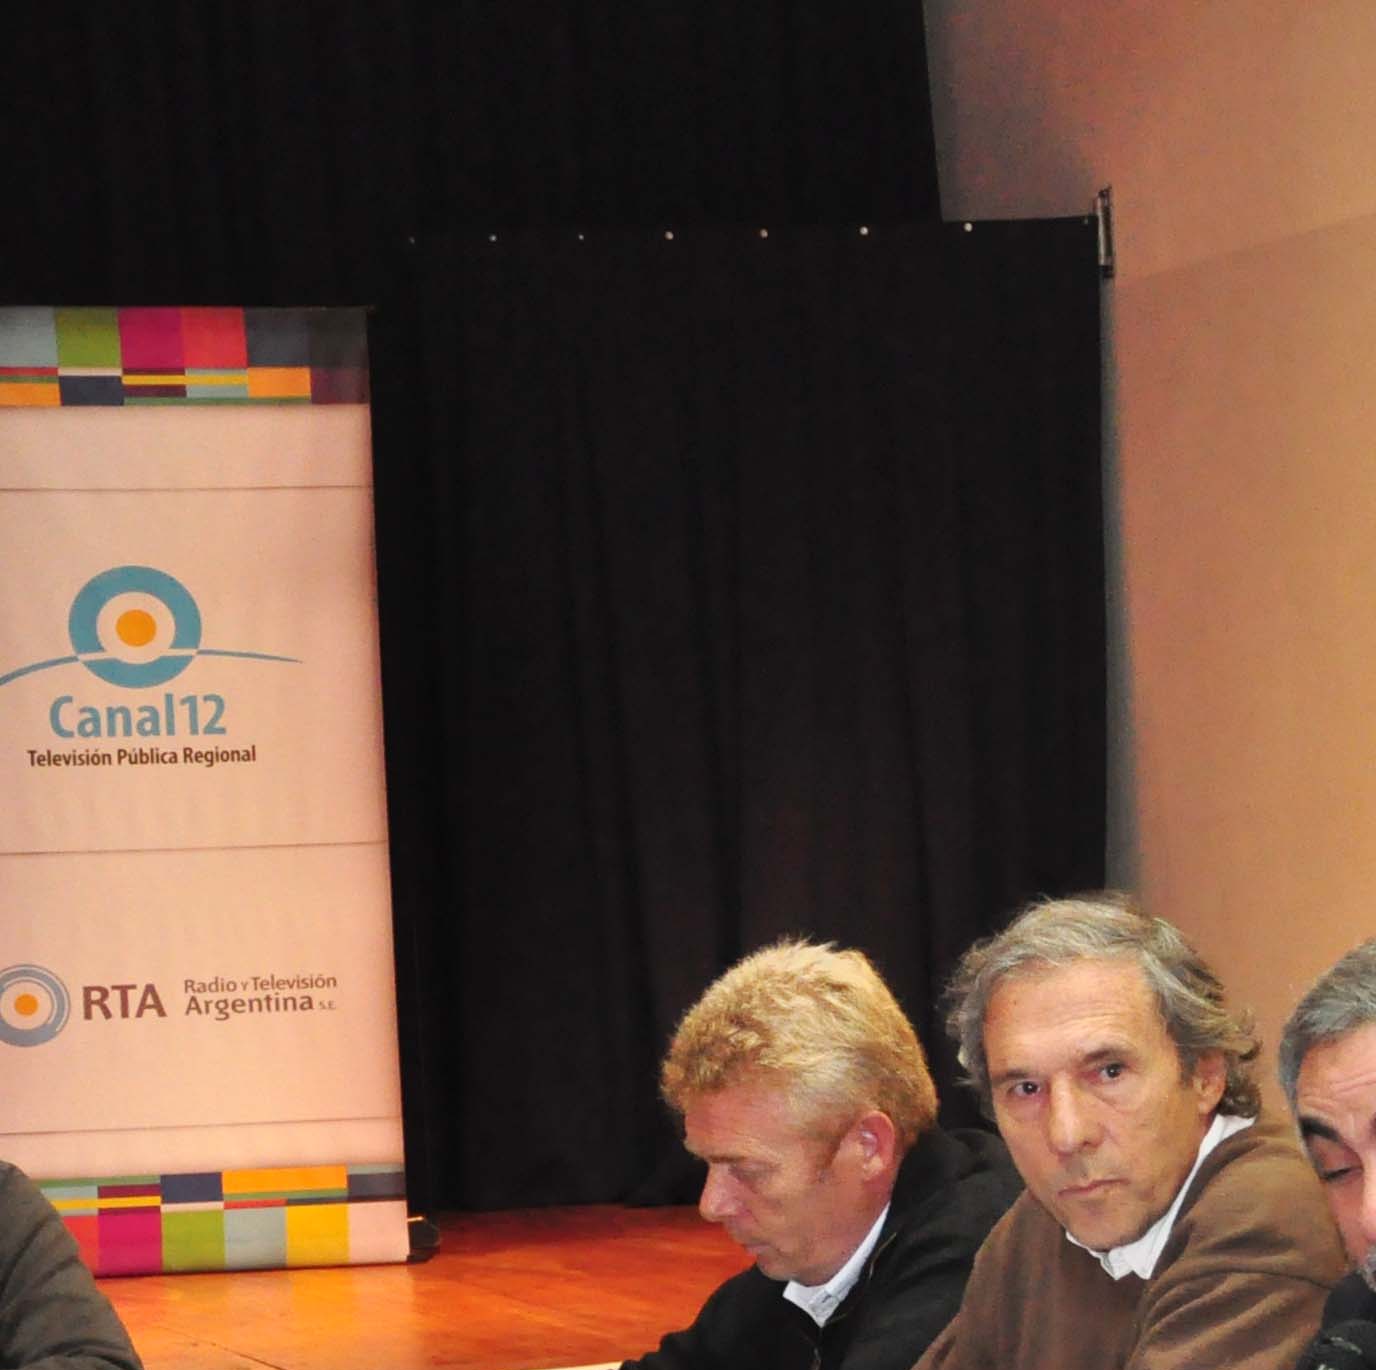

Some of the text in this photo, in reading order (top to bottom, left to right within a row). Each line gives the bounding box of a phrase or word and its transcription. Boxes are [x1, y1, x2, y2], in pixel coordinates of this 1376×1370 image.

[28, 745, 256, 767] Televisión Pública Regional
[184, 976, 237, 994] Radio
[252, 974, 338, 991] Televisión
[82, 983, 168, 1021] RTA
[185, 992, 314, 1021] Argentina
